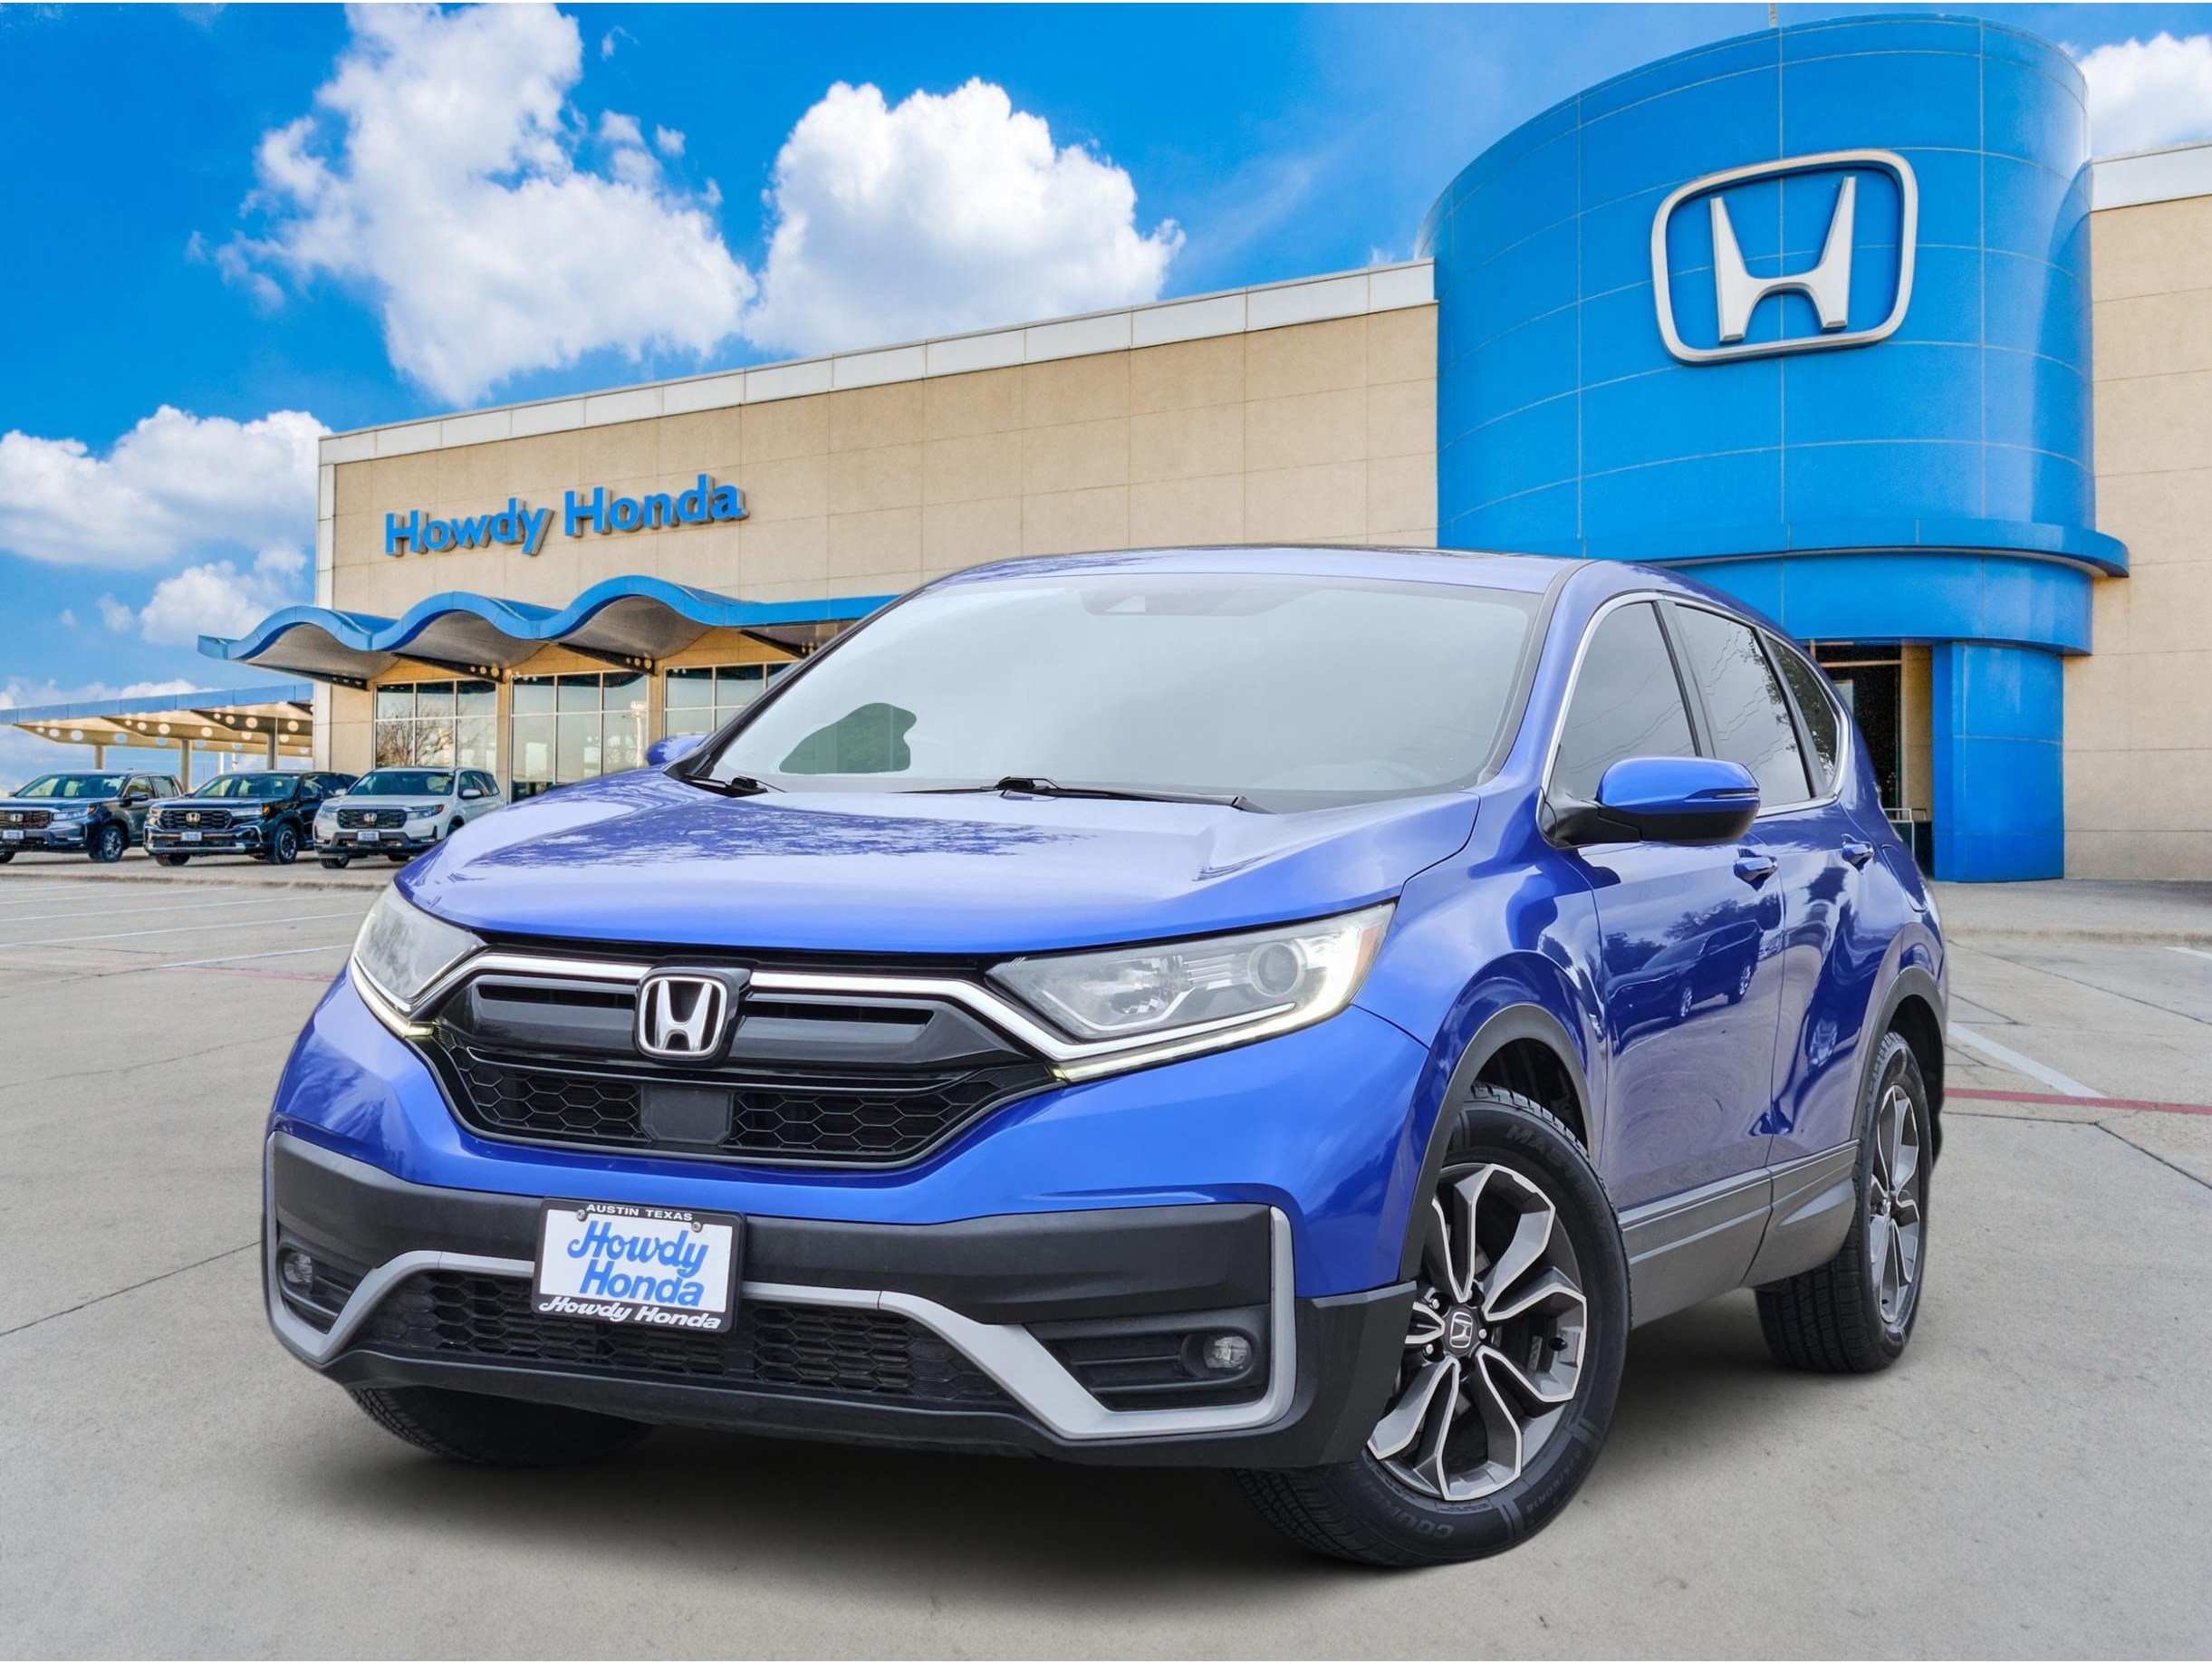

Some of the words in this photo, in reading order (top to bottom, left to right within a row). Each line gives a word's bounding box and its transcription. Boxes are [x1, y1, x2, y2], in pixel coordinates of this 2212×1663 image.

[385, 497, 555, 556] Howdy
[564, 474, 749, 538] Honda
[586, 1204, 639, 1216] AUSTIN
[645, 1208, 693, 1221] TEXAS
[567, 1220, 708, 1278] Howdy
[579, 1259, 705, 1306] Honda
[539, 1296, 632, 1322] Howdy
[635, 1305, 722, 1329] Honda
